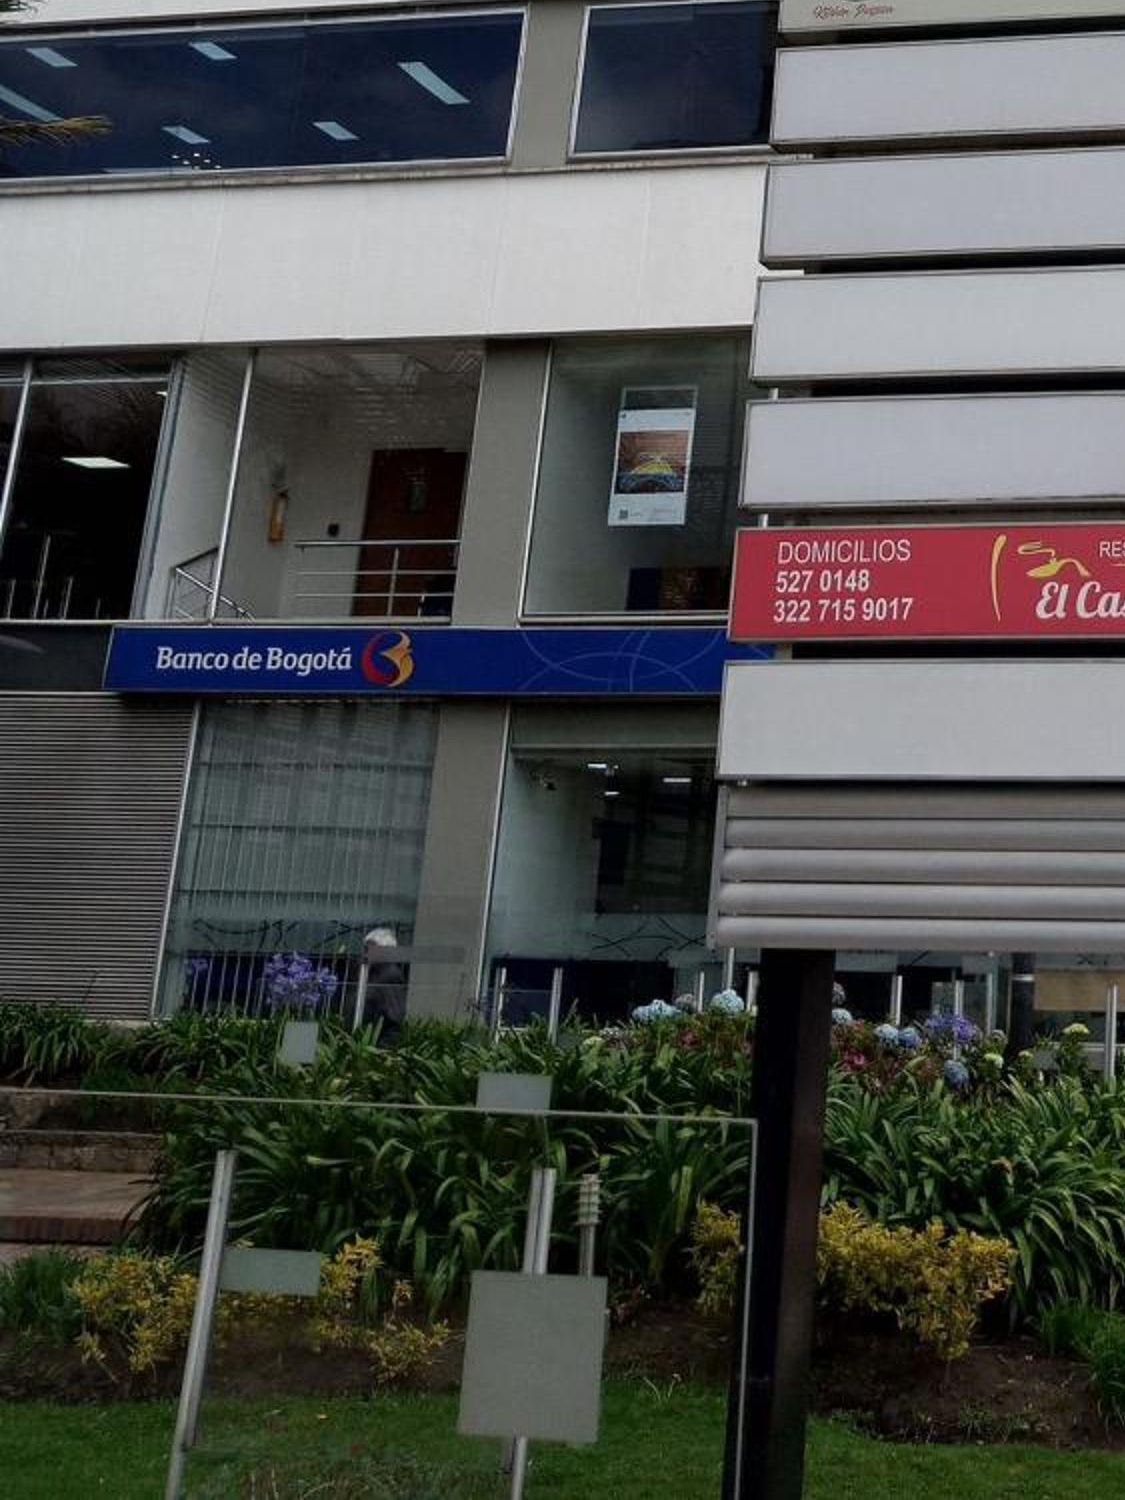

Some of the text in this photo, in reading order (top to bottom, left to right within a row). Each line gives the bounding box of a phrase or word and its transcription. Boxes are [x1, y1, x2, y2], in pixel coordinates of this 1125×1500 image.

[777, 540, 912, 565] DOMICILIOS
[776, 569, 870, 593] 527 0148
[773, 597, 914, 623] 322 715 9017
[1034, 581, 1067, 619] El
[156, 646, 352, 676] Banco de Bogotá
